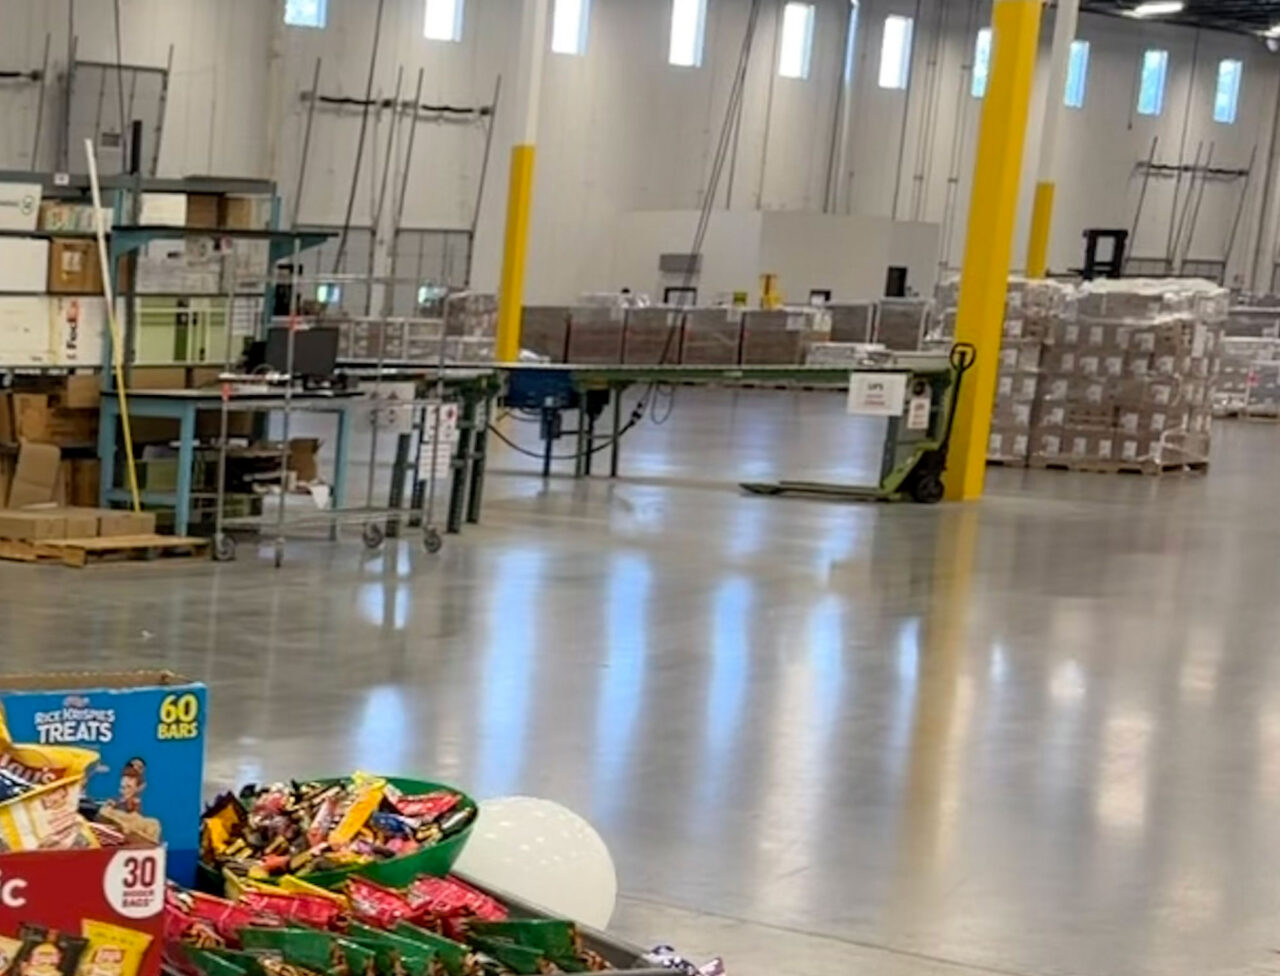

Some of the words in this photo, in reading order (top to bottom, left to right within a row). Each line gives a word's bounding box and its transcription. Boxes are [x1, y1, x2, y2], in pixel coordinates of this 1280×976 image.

[160, 694, 199, 723] 60
[37, 721, 112, 744] TREATS
[157, 722, 199, 740] BARS
[122, 856, 156, 888] 30
